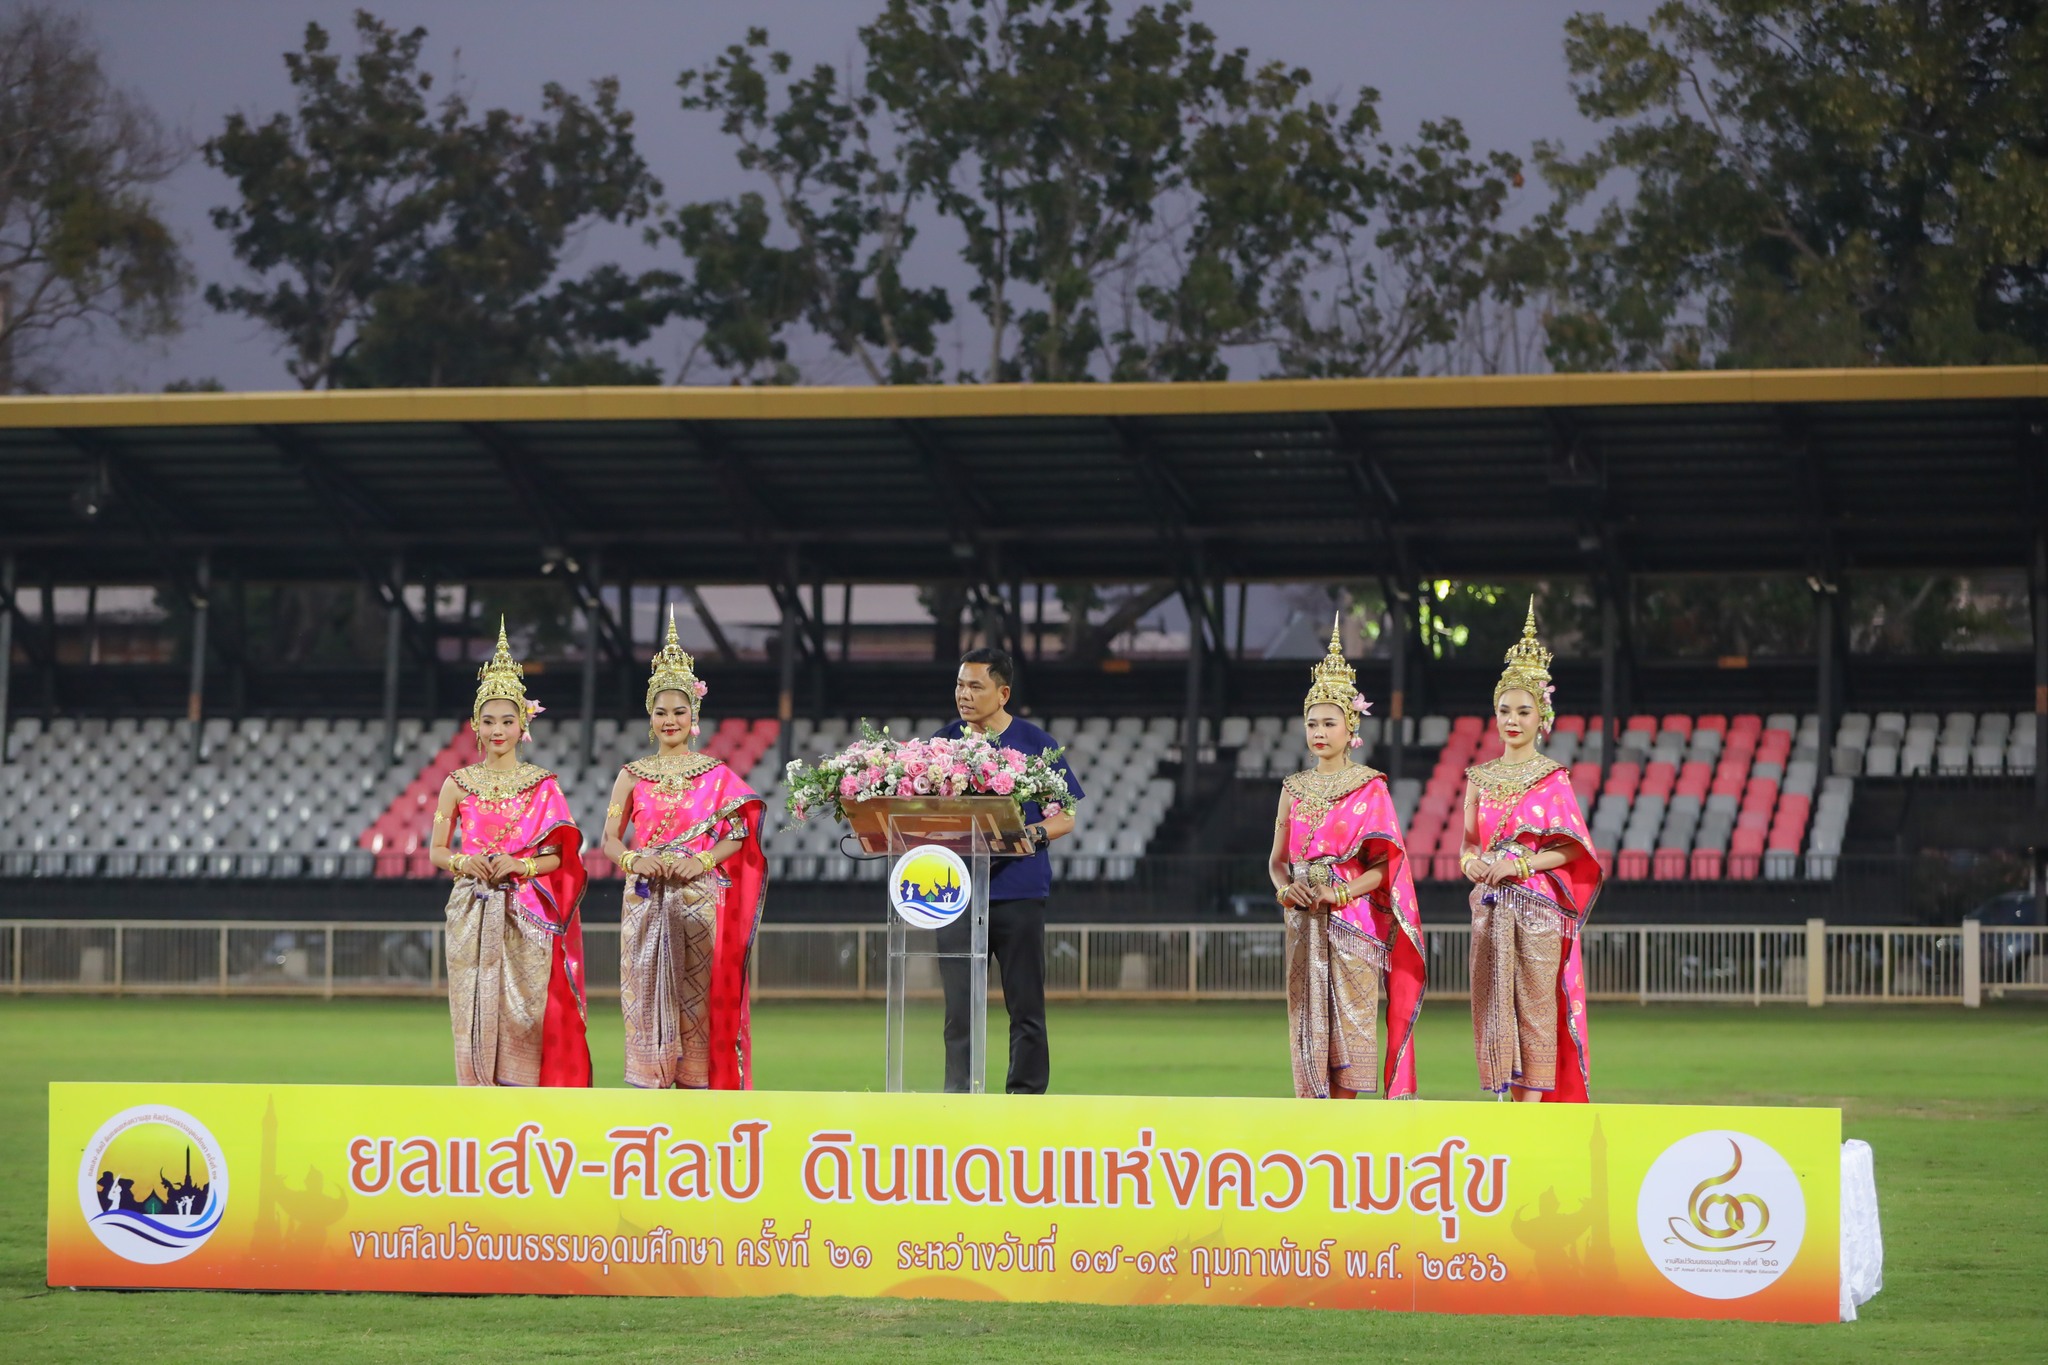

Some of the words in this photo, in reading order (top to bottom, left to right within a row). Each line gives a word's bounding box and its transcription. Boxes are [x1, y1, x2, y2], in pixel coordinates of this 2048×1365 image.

[349, 1121, 770, 1200] ยลแสง-ศิลป์
[803, 1129, 1509, 1240] ดินแดนแห่งความสุข
[350, 1221, 724, 1275] งานศิลปวัฒนธรรมอุดมศึกษา
[736, 1218, 812, 1267] ครั้งที่
[824, 1238, 873, 1268] ๒๑
[897, 1224, 1058, 1272] ระหว่างวันที่
[1071, 1246, 1179, 1275] ๑๗-๑๙
[1191, 1237, 1337, 1288] กุมภาพันธ์
[1345, 1243, 1403, 1279] พ.ศ.
[1417, 1251, 1508, 1282] ๒๕๖๖
[1760, 1257, 1779, 1267] ๒๑
